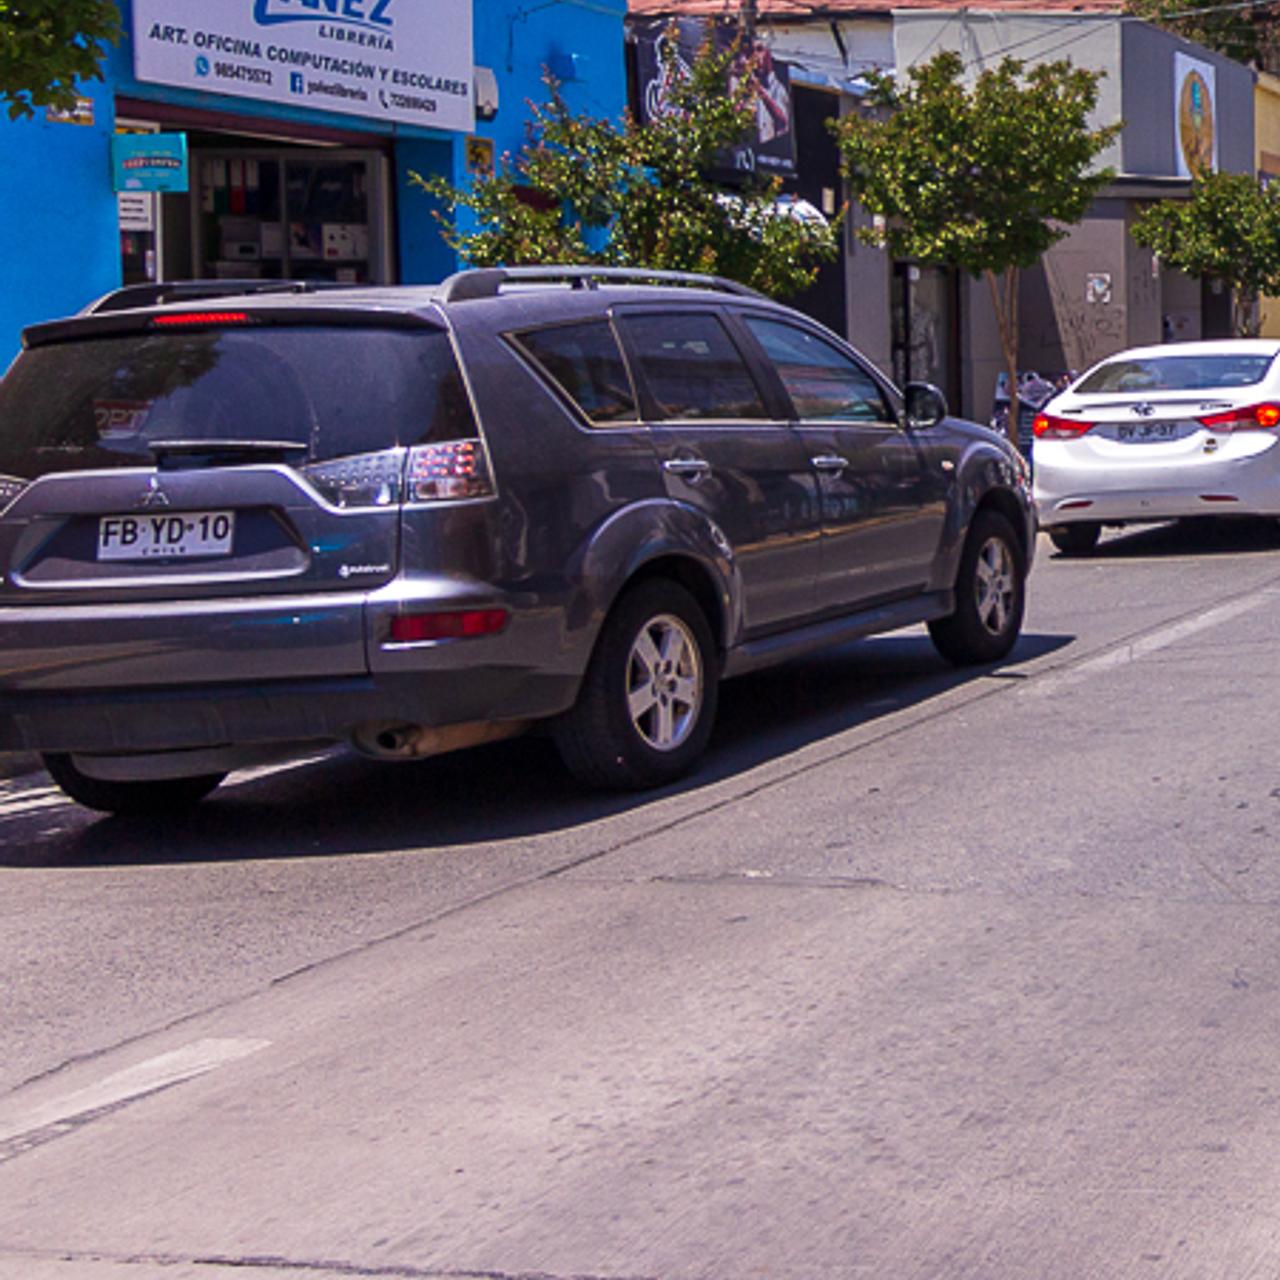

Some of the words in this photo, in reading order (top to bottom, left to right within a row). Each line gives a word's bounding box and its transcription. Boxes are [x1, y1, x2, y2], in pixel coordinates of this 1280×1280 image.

[149, 23, 188, 45] ART.
[193, 31, 262, 58] OFICINA
[267, 45, 375, 80] COMPUTACIÓN
[379, 65, 389, 81] Y
[392, 69, 468, 96] ESCOLARES
[319, 24, 394, 52] LIBRERÍA
